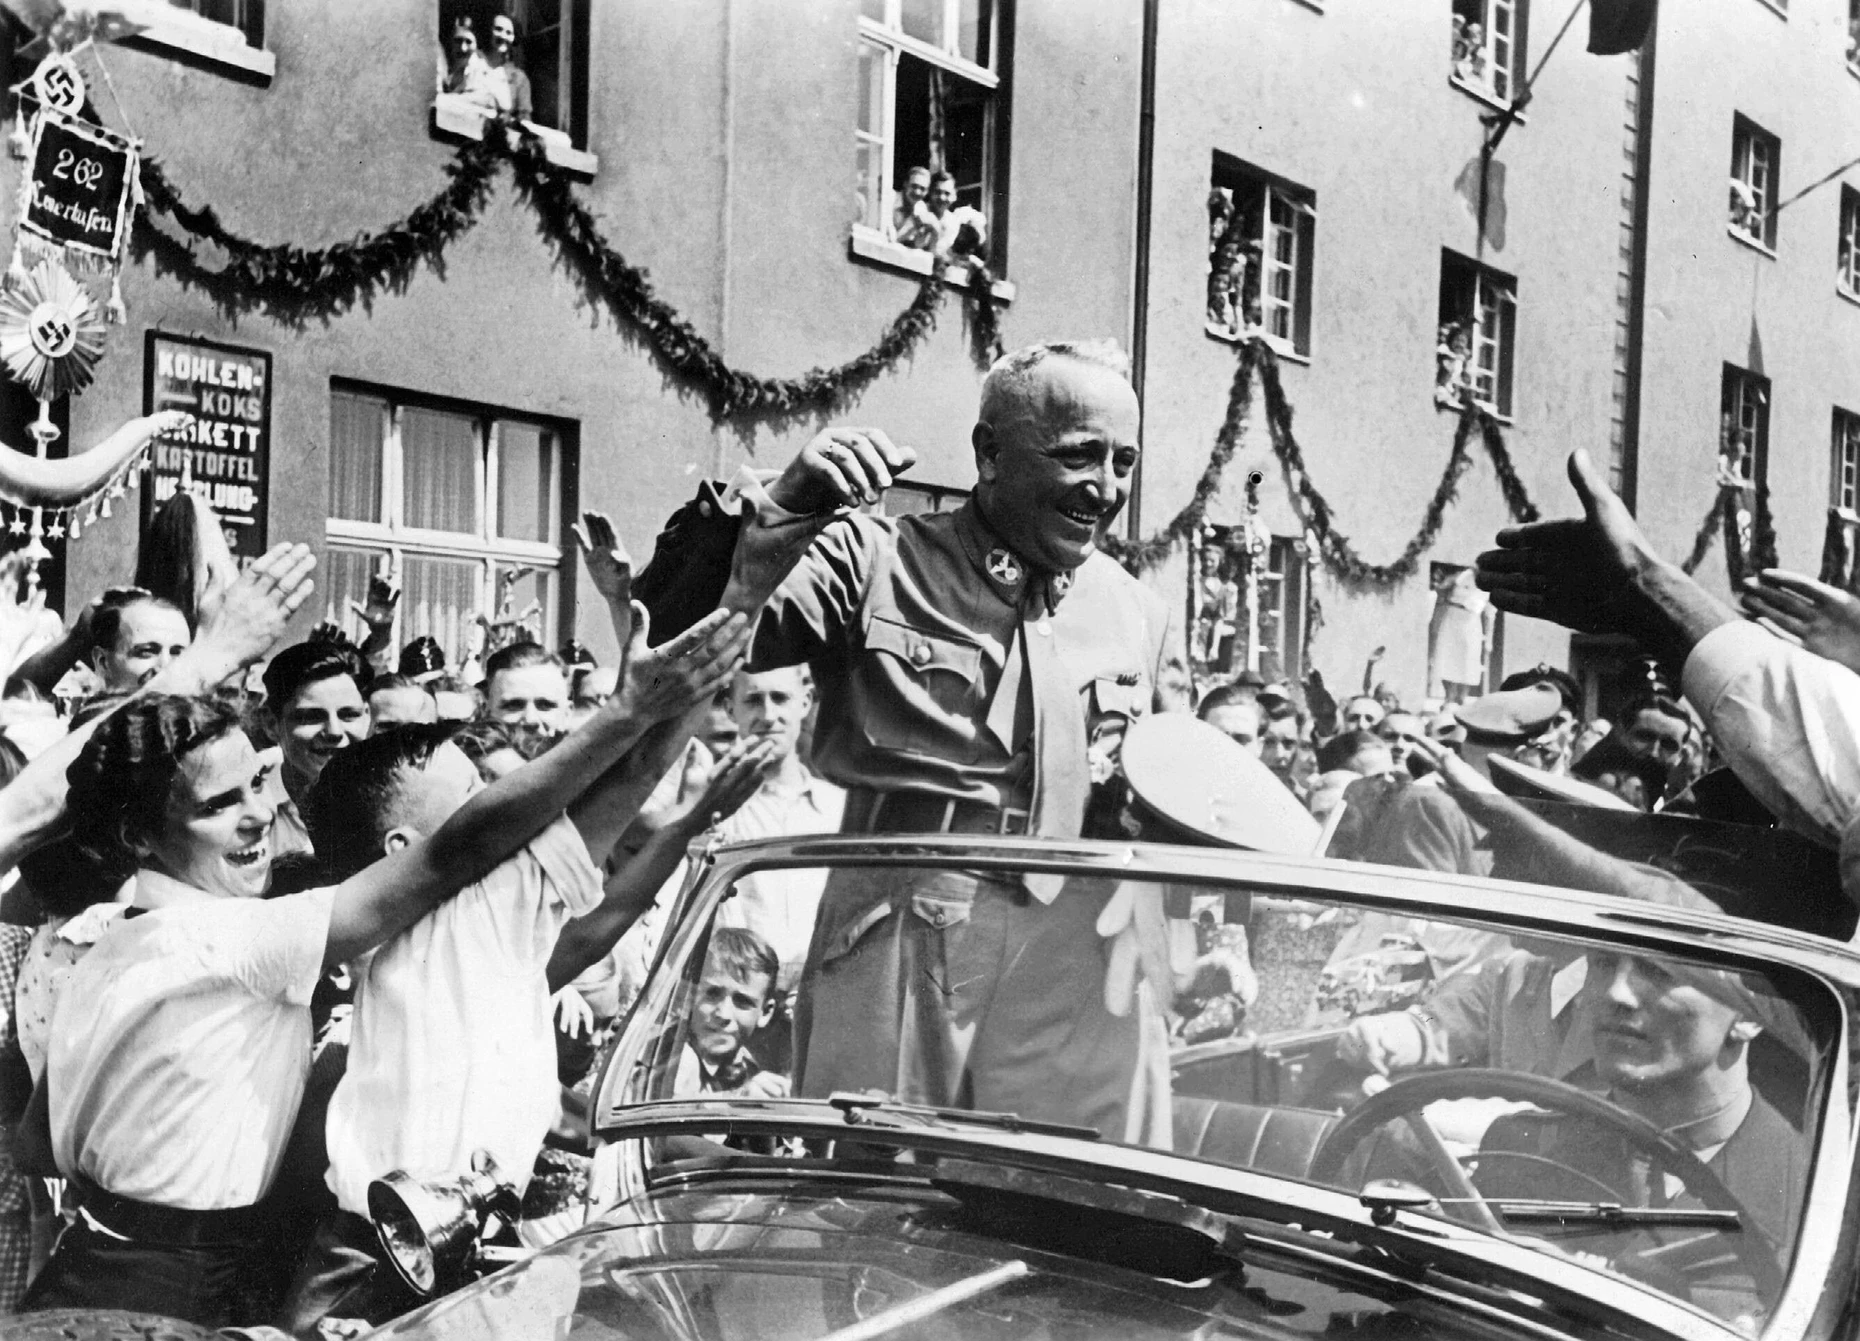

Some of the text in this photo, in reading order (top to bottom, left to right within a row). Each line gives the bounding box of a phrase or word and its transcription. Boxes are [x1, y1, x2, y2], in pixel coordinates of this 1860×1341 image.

[53, 148, 103, 191] 262
[201, 389, 262, 421] KOKS
[160, 415, 261, 452] IKETT
